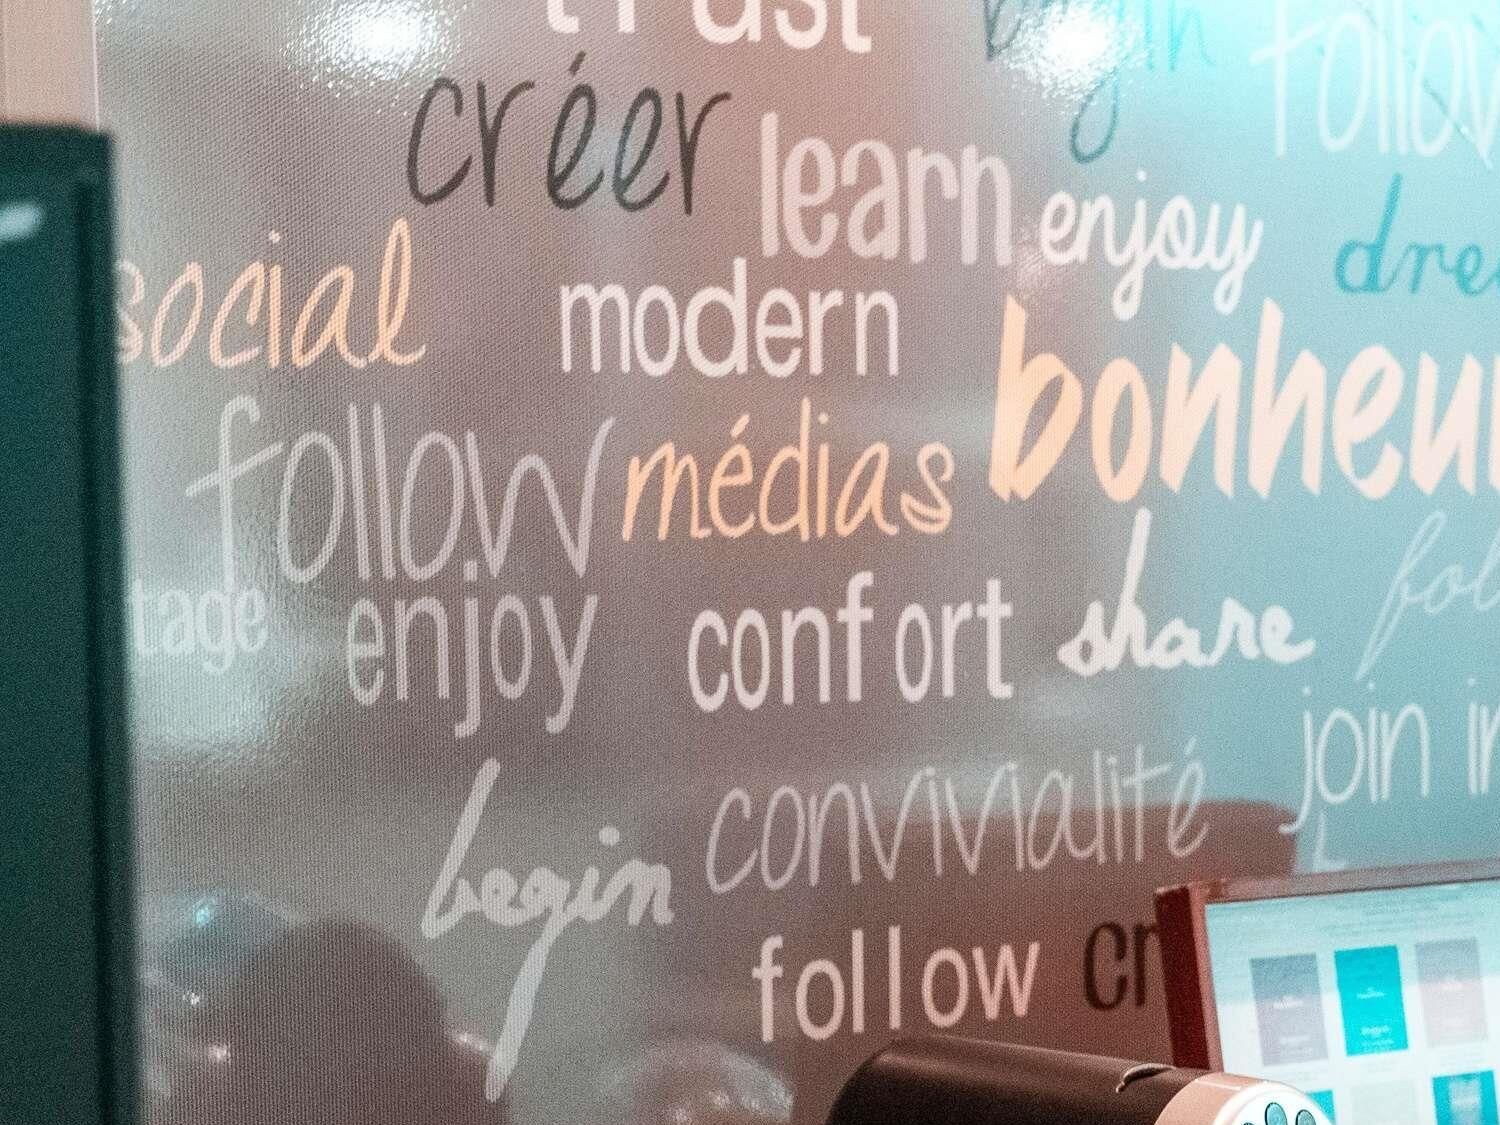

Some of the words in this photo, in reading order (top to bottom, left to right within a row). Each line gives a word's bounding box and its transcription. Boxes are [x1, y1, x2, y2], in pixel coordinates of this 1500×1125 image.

[406, 52, 732, 216] créer
[759, 112, 1013, 266] learn
[116, 216, 427, 370] social
[560, 258, 900, 378] modern
[1038, 170, 1264, 320] enjoy
[622, 398, 954, 544] médias
[346, 562, 598, 738] enjoy
[688, 572, 1012, 712] confort
[1057, 508, 1316, 678] share
[704, 736, 1210, 896] convivialité
[1279, 686, 1430, 834] join
[420, 758, 674, 1102] begin
[752, 926, 1042, 1046] follow
